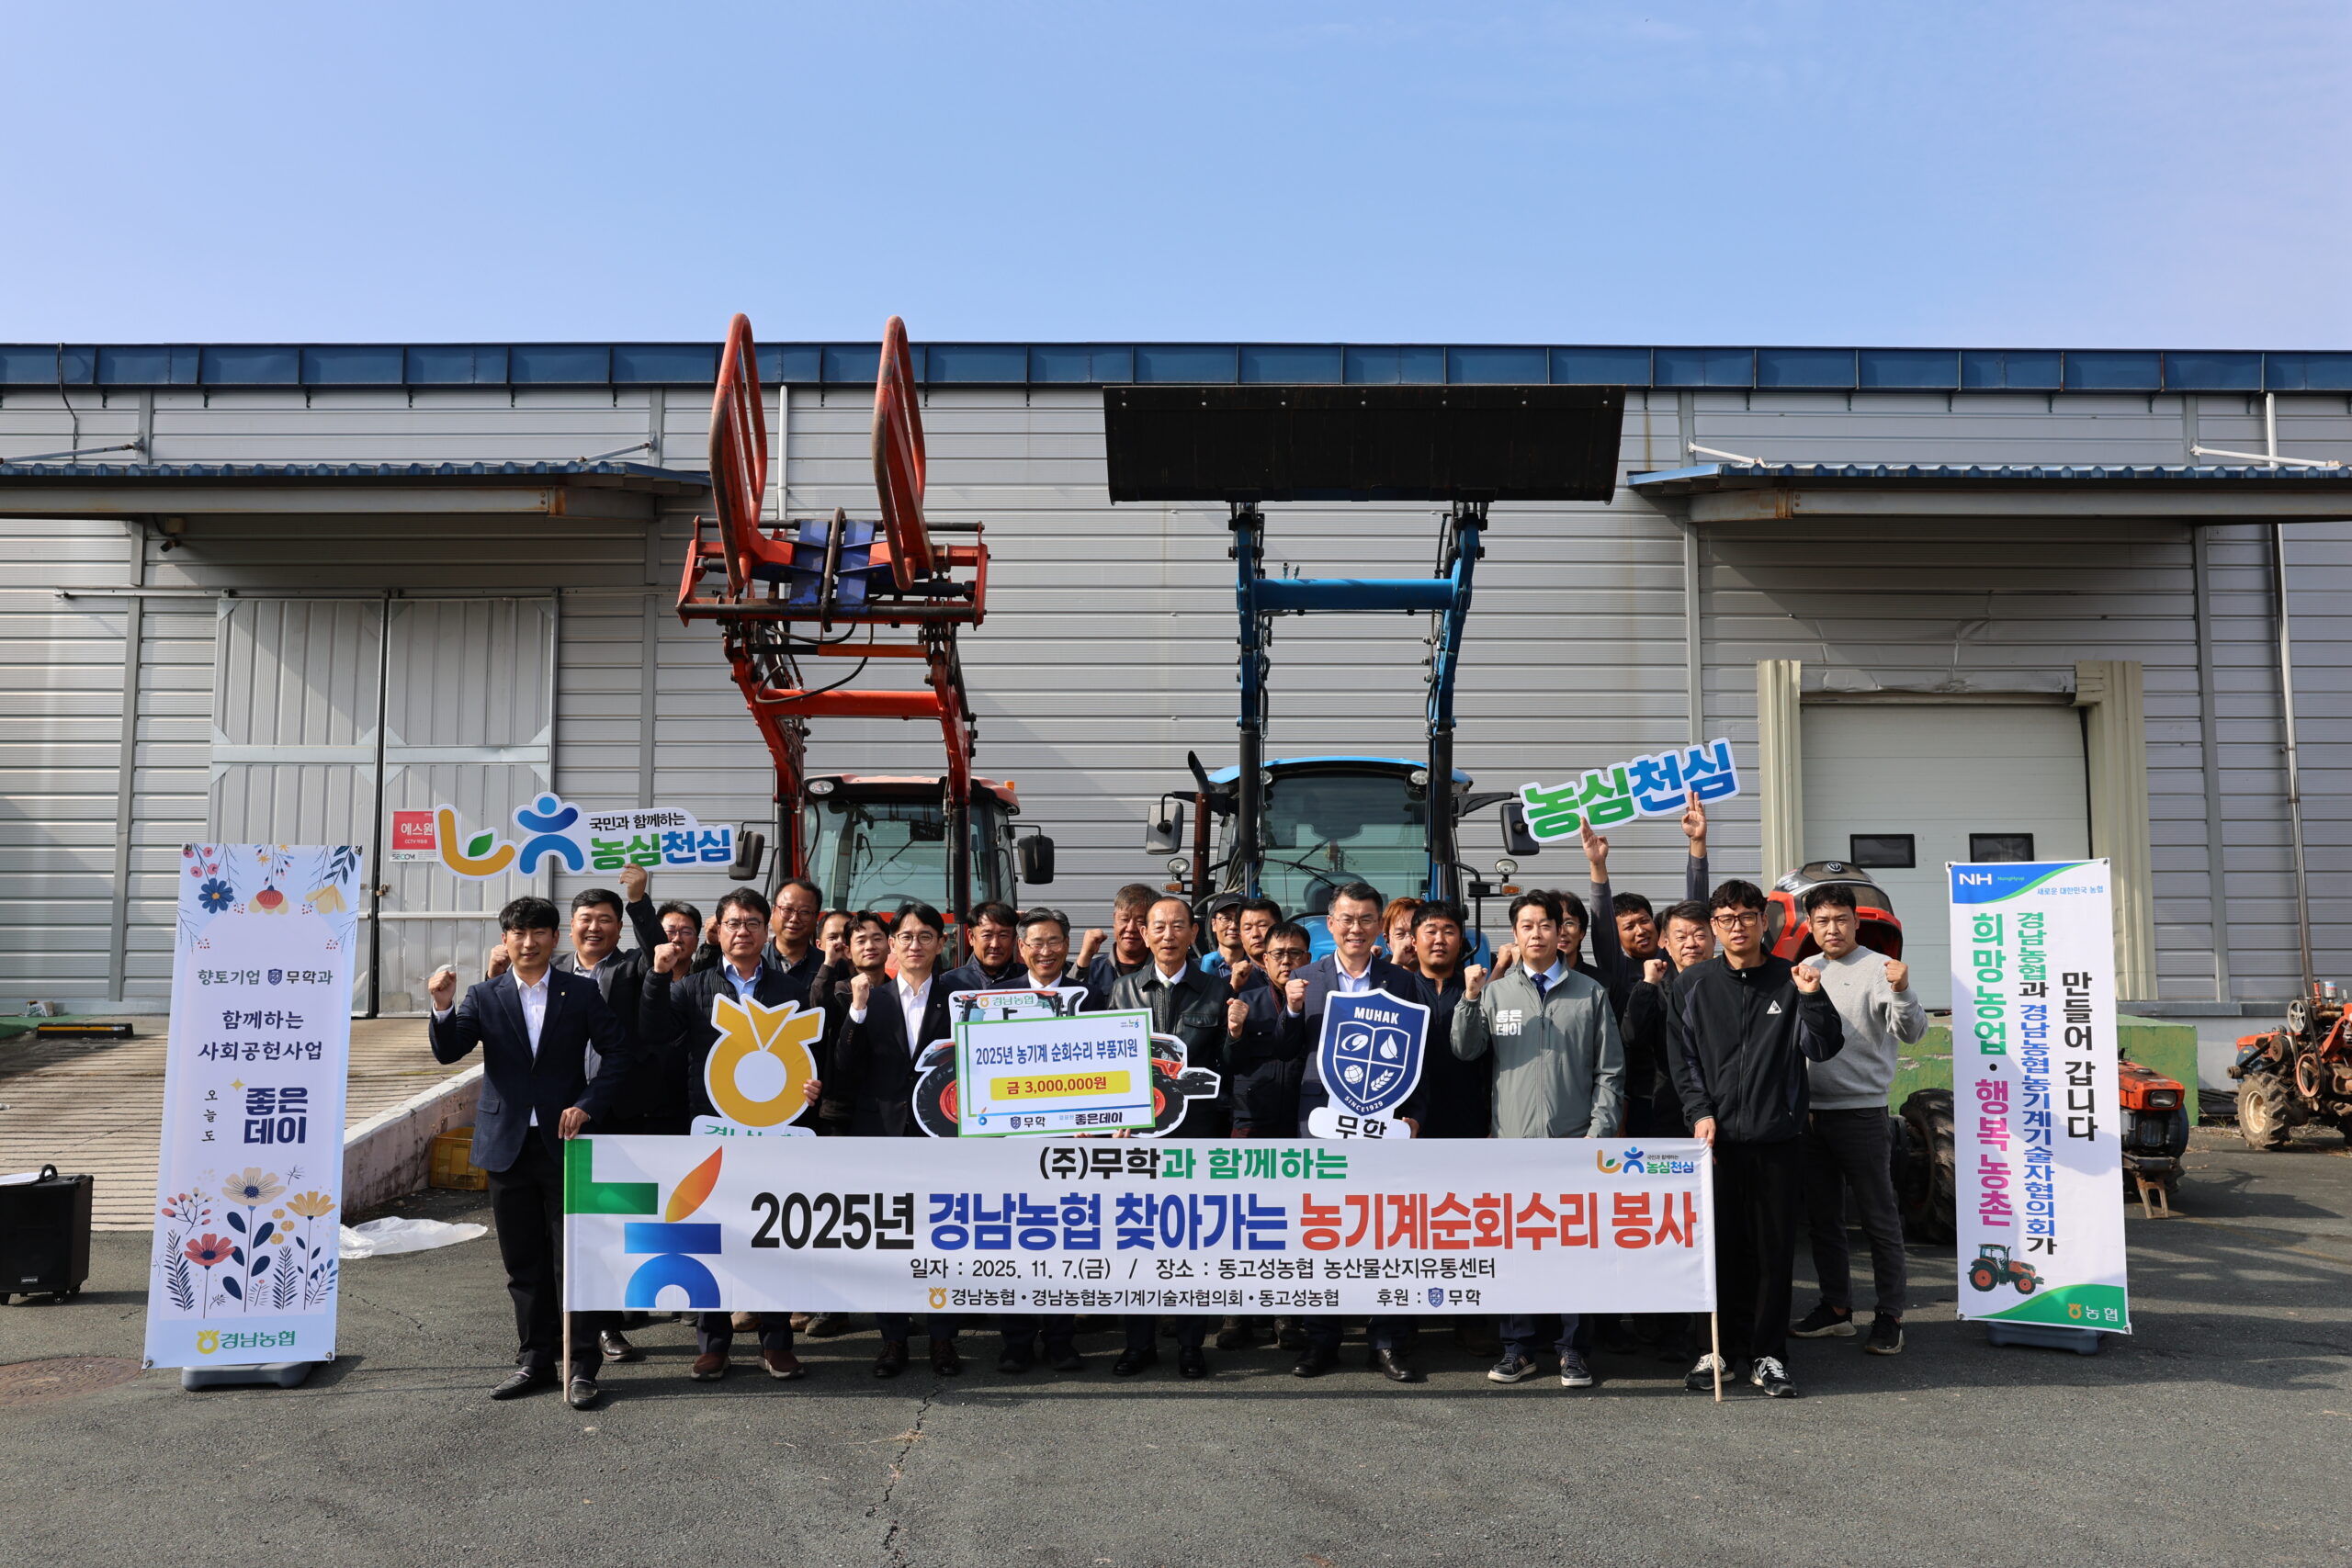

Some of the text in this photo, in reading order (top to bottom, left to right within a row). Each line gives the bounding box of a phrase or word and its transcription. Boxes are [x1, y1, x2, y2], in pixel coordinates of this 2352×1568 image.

[1524, 742, 1736, 838] 농심천심
[401, 823, 434, 836] 에스원
[589, 813, 685, 830] 국민과 함께하는
[591, 829, 731, 871] 농심천심
[1959, 874, 1992, 885] NH
[2060, 886, 2087, 895] 대한민국
[2018, 912, 2049, 998] 경남농협과
[198, 969, 333, 986] 향토기업 무학과
[1973, 913, 2007, 1055] 희망농업
[222, 1010, 304, 1030] 함께하는
[1353, 1007, 1398, 1024] MUHAK
[1495, 1010, 1521, 1022] 좋은
[1495, 1024, 1521, 1035] 데이
[198, 1041, 322, 1062] 사회공헌사업
[976, 1038, 1138, 1066] 2025년 농기계 순회수리 부품지원
[2063, 972, 2098, 1142] 만들어 갑니다
[1007, 1076, 1107, 1095] 금 3,000,000원
[245, 1088, 308, 1115] 좋은
[1024, 1116, 1046, 1127] 무학
[1075, 1112, 1123, 1125] 좋은데이
[243, 1116, 307, 1145] 데이
[1039, 1146, 1348, 1179] (주)무학과 함께하는
[1647, 1161, 1694, 1174] 농심천심
[751, 1191, 1697, 1250] 2025년 경남농협 찾아가는 농기계순회수리 봉사
[910, 1259, 948, 1278] 일자
[972, 1260, 1022, 1279] 2025.
[1032, 1261, 1052, 1279] 11.
[1156, 1259, 1193, 1279] 장소
[1217, 1258, 1314, 1280] 동고성농협
[1324, 1258, 1496, 1280] 농산물산지유통센터
[952, 1289, 1015, 1308] 경남농협
[1258, 1289, 1340, 1308] 동고성농협
[1377, 1290, 1409, 1307] 후원
[1448, 1290, 1481, 1307] 무학
[220, 1330, 295, 1348] 경남농협
